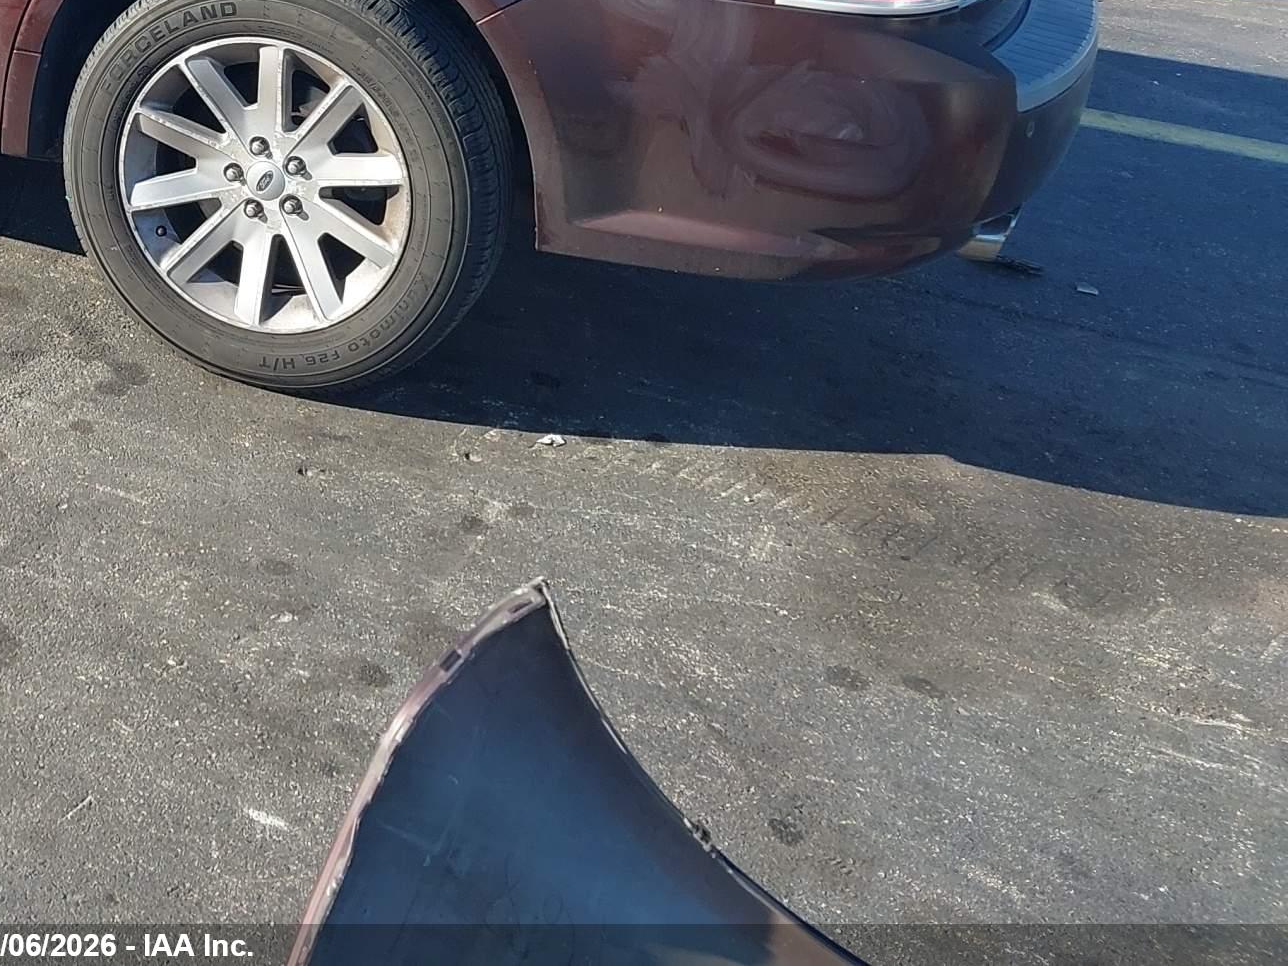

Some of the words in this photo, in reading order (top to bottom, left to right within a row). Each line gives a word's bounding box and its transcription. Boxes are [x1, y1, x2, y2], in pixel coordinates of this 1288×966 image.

[101, 1, 238, 93] FORCELAND
[259, 355, 296, 371] H/T
[304, 349, 340, 367] F26
